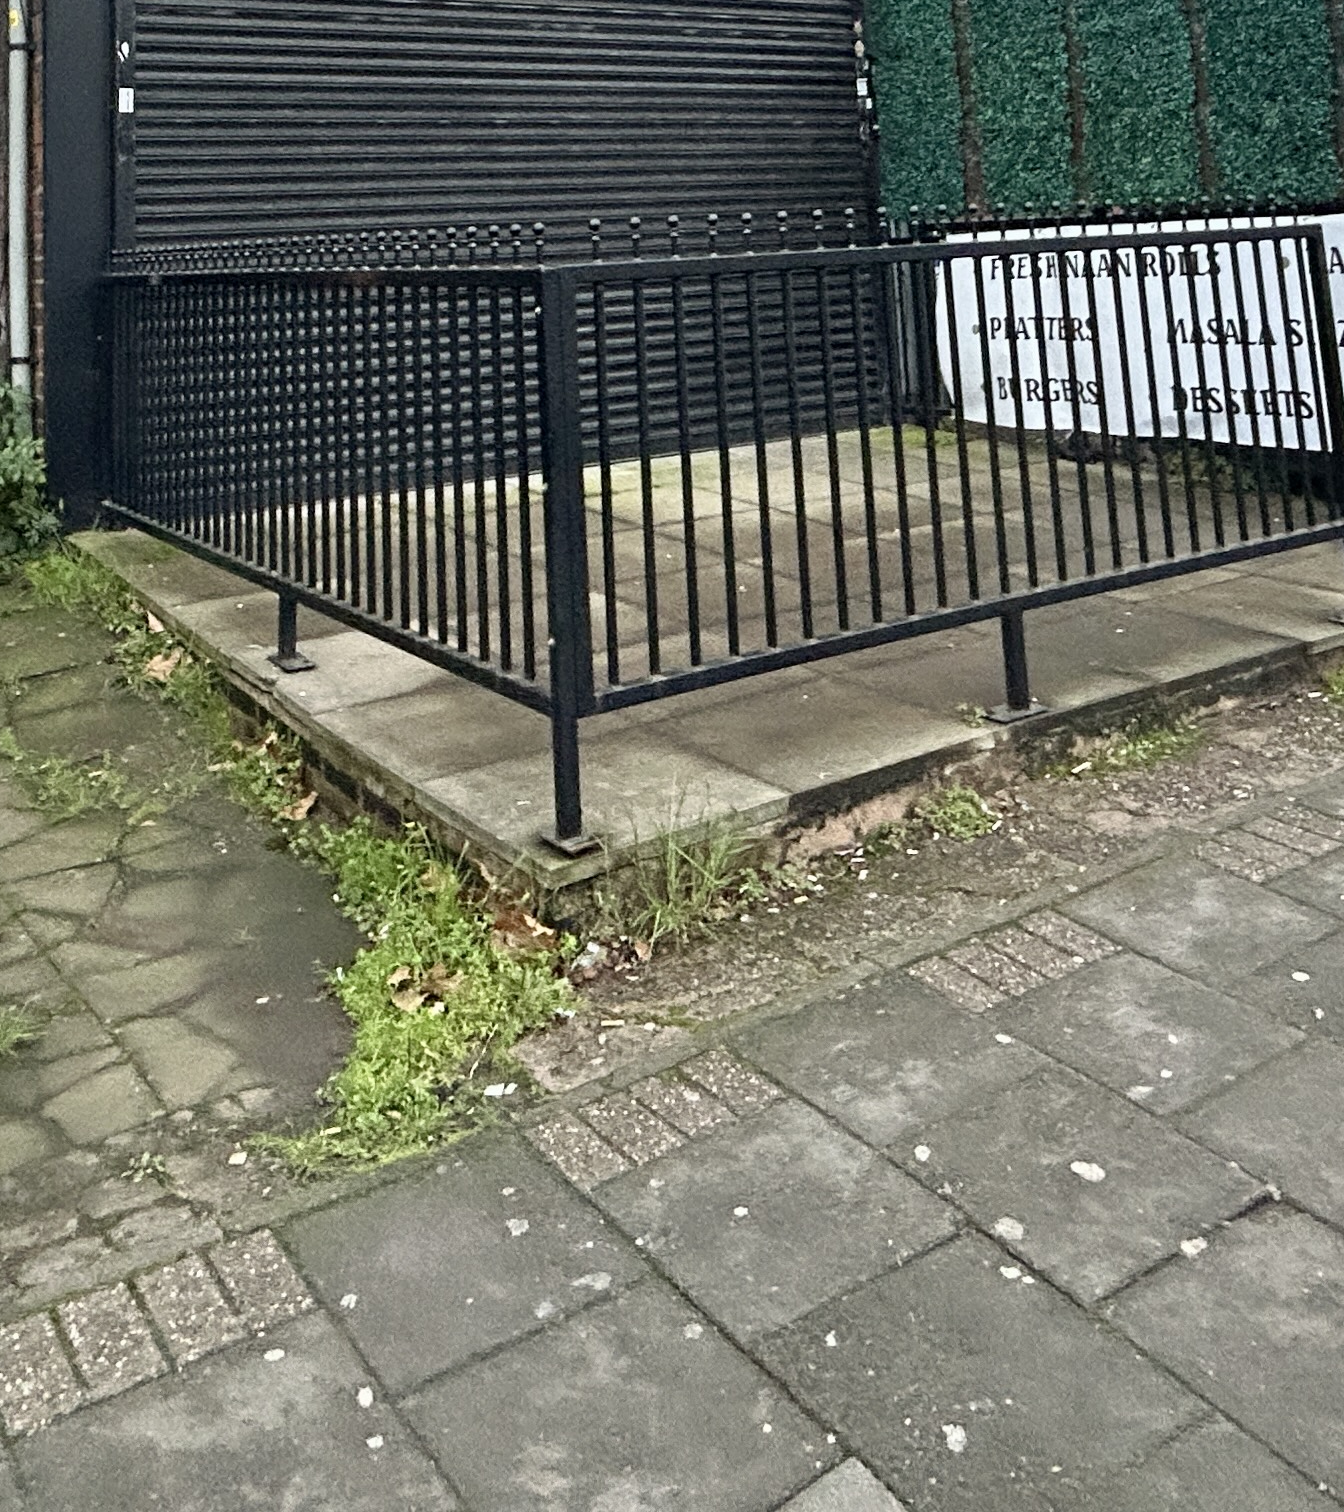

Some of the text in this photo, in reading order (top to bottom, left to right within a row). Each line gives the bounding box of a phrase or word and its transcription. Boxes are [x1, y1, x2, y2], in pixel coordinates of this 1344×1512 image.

[990, 316, 1093, 342] PATTERS
[1167, 318, 1277, 346] MSALA
[997, 376, 1100, 405] BRGERS
